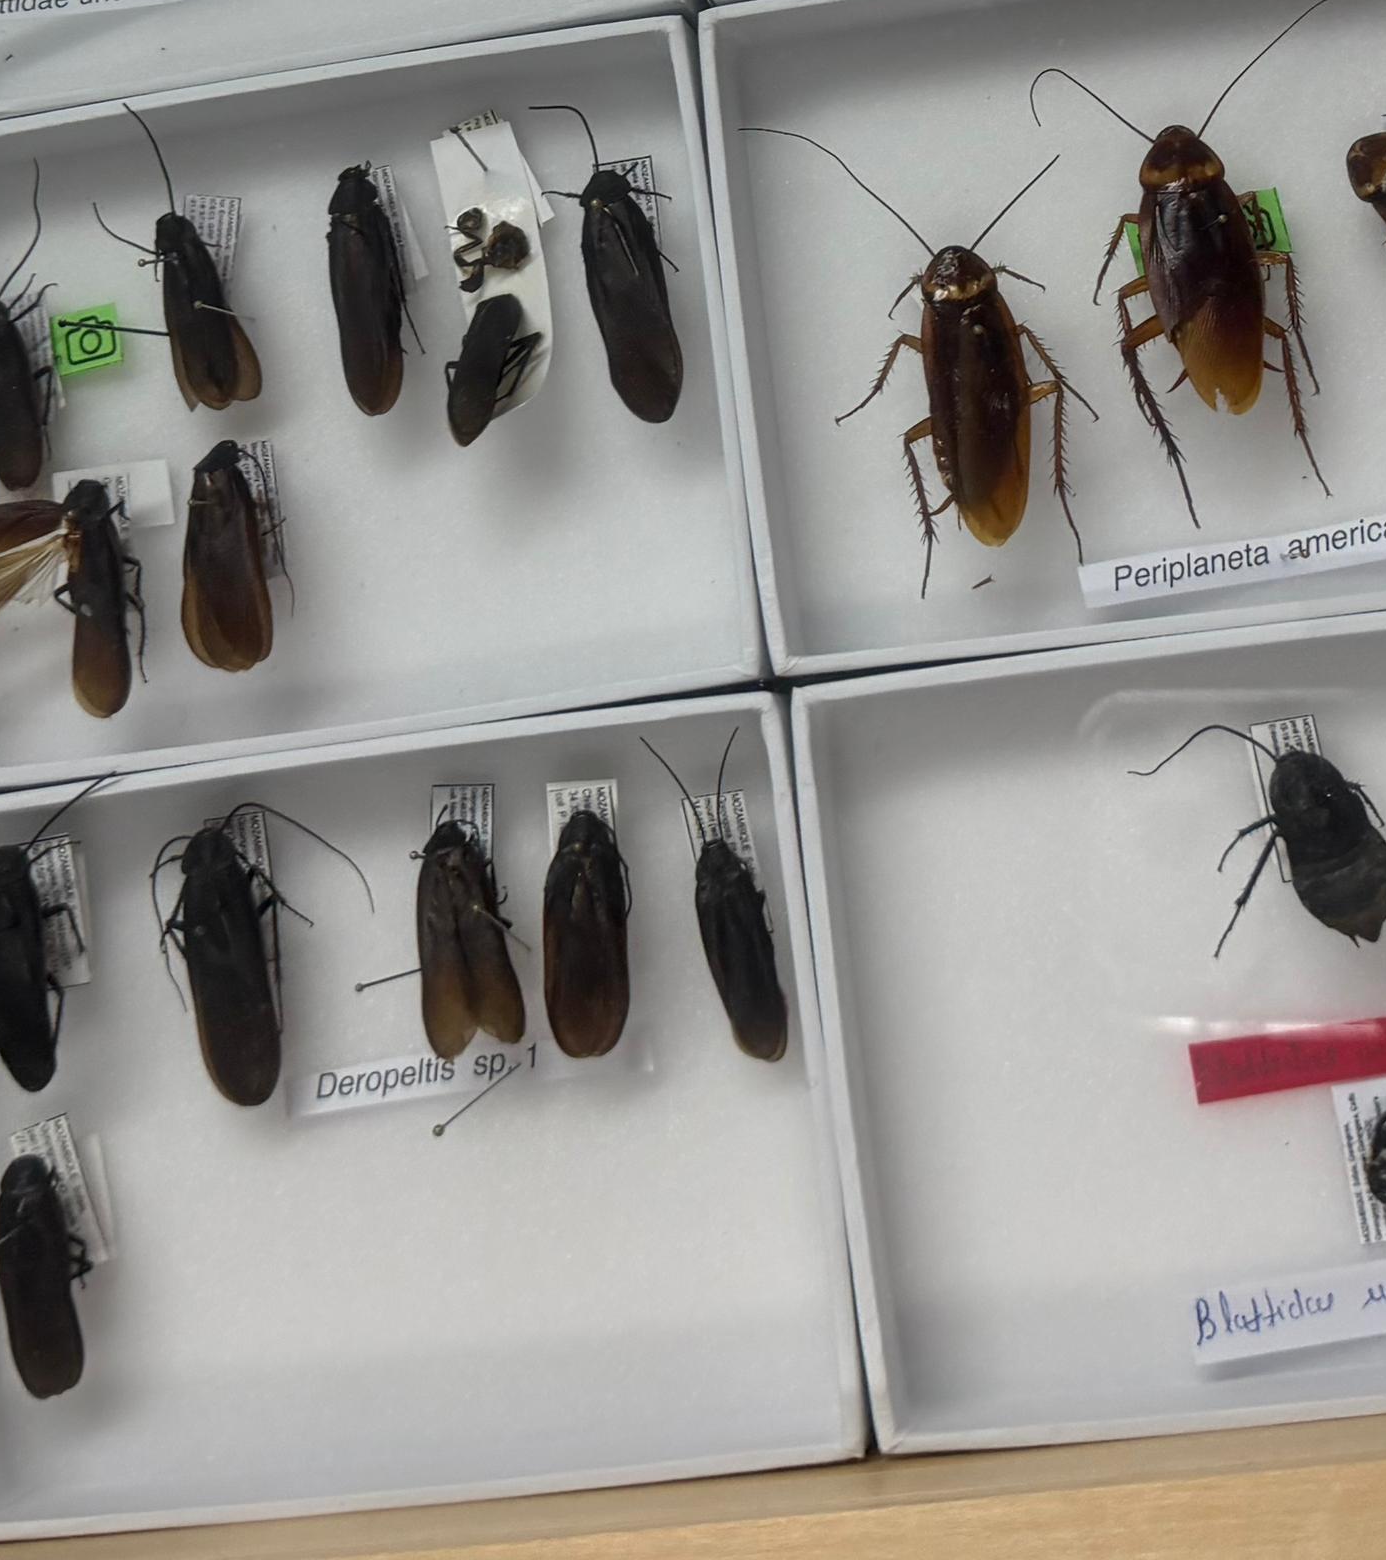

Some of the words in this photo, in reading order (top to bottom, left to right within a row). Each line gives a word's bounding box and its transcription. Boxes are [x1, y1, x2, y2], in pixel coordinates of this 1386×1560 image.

[1114, 543, 1270, 592] Periplaneta
[316, 1057, 456, 1100] Deropeltis
[473, 1052, 513, 1081] sp.
[527, 1043, 538, 1068] 1
